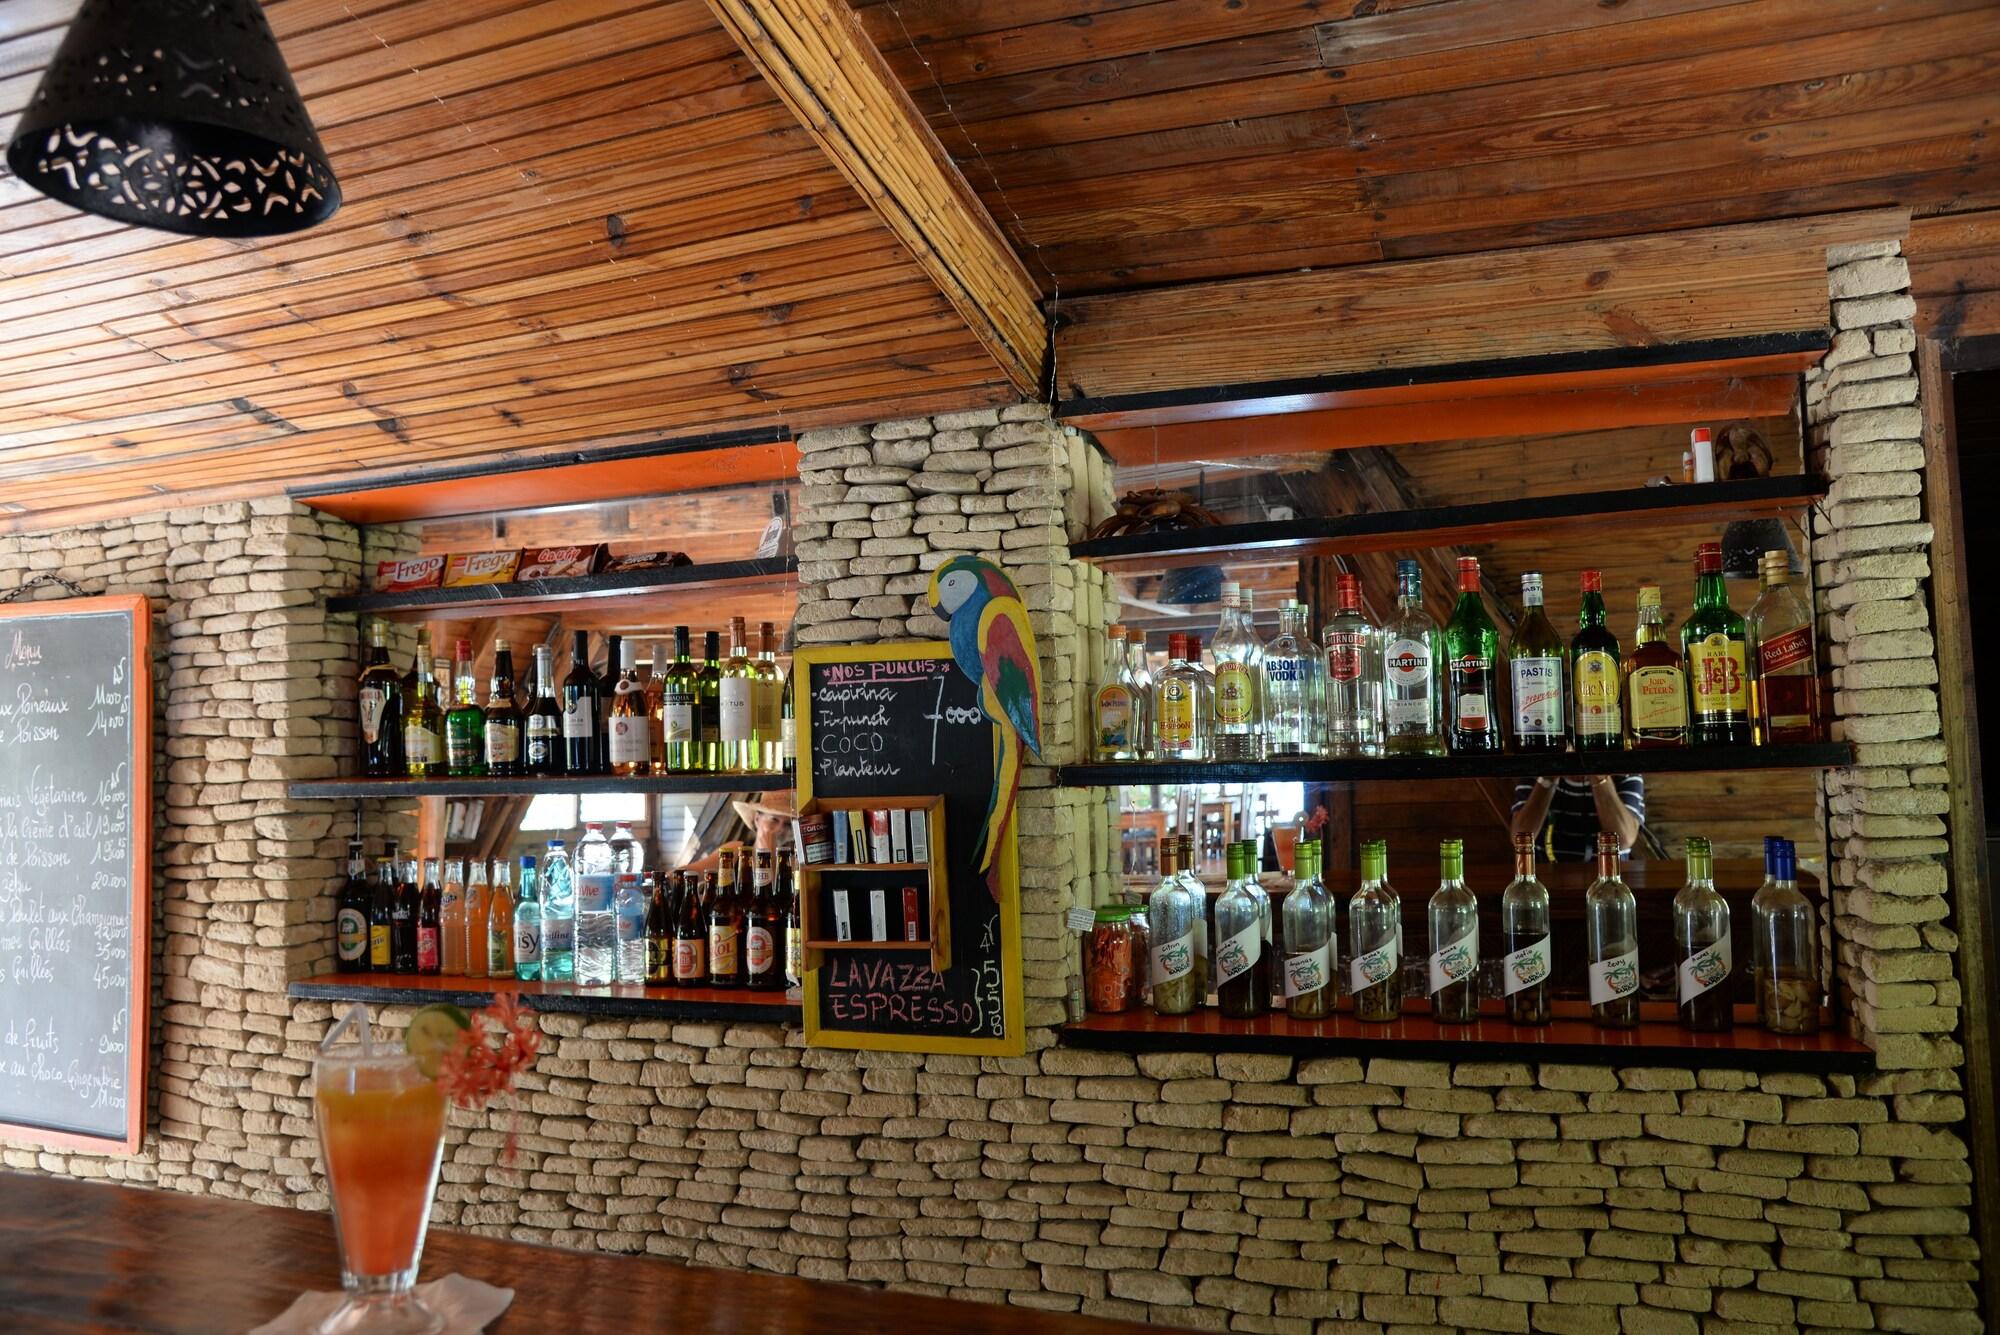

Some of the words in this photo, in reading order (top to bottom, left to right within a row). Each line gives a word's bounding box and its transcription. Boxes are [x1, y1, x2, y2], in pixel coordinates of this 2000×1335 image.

[397, 558, 438, 580] Frego
[467, 553, 511, 573] Frego
[1763, 648, 1783, 661] Red
[1783, 638, 1809, 654] Label
[831, 665, 865, 683] NOS
[868, 659, 936, 681] PUNCHS
[1266, 659, 1311, 671] ABSOLUT
[1388, 658, 1427, 668] MARTINI
[1452, 660, 1489, 669] MARTINI
[1521, 667, 1553, 678] PASTIS
[1269, 670, 1305, 682] VODKA
[1698, 656, 1741, 695] J&B
[821, 732, 884, 754] COCO
[820, 755, 900, 777] Planteur
[829, 957, 946, 992] LAVAZZA
[829, 991, 973, 1025] ESPRESSO
